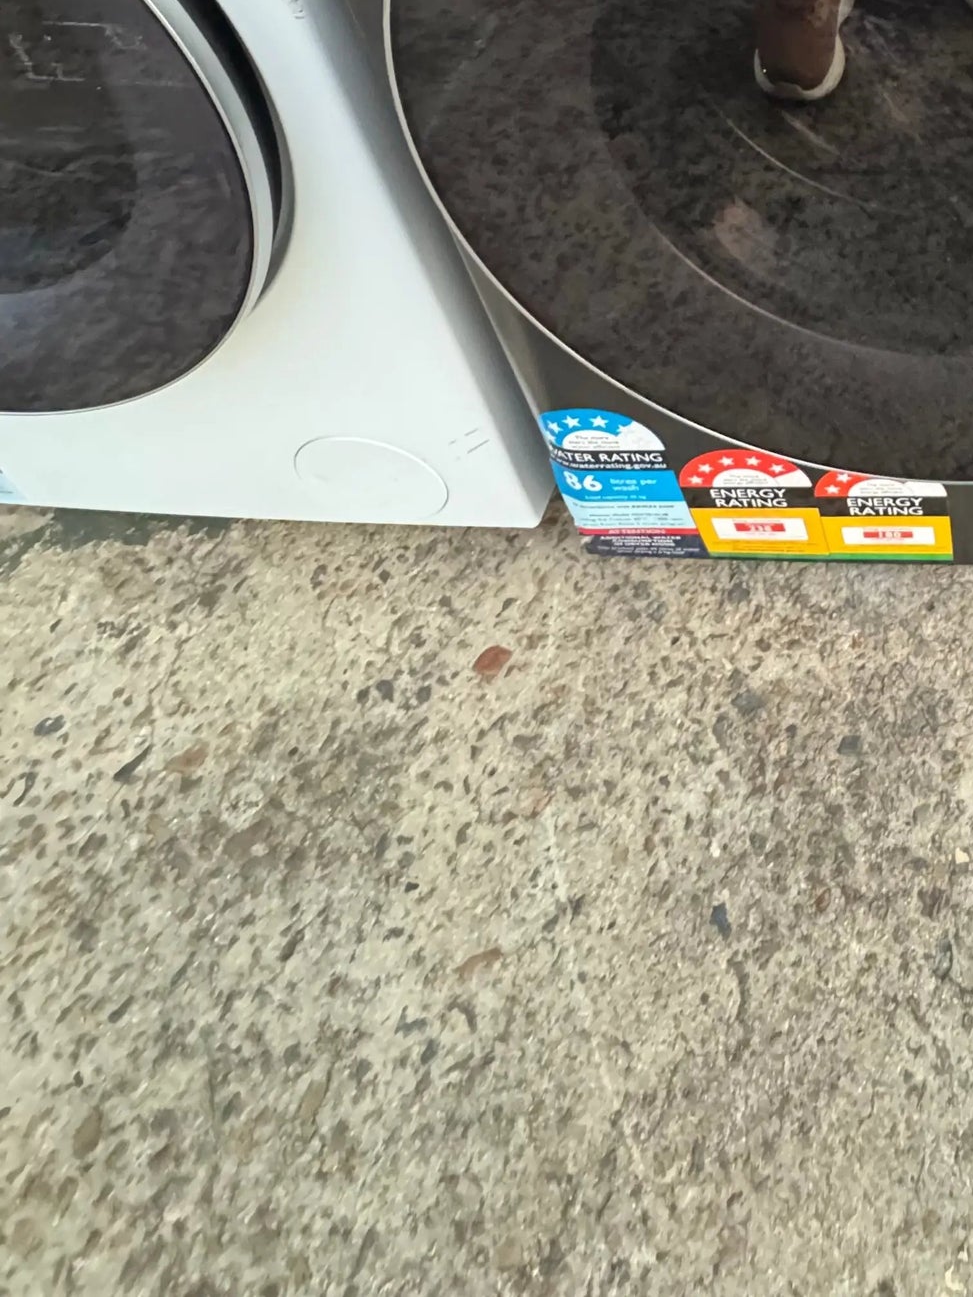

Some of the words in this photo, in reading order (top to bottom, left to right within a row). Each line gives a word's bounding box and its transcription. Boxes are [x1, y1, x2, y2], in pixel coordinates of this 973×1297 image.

[599, 452, 663, 463] RATING
[563, 471, 603, 491] 86
[710, 488, 786, 498] ENERGY
[715, 498, 788, 507] RATING
[847, 498, 923, 507] ENERGY
[850, 507, 924, 515] RATING
